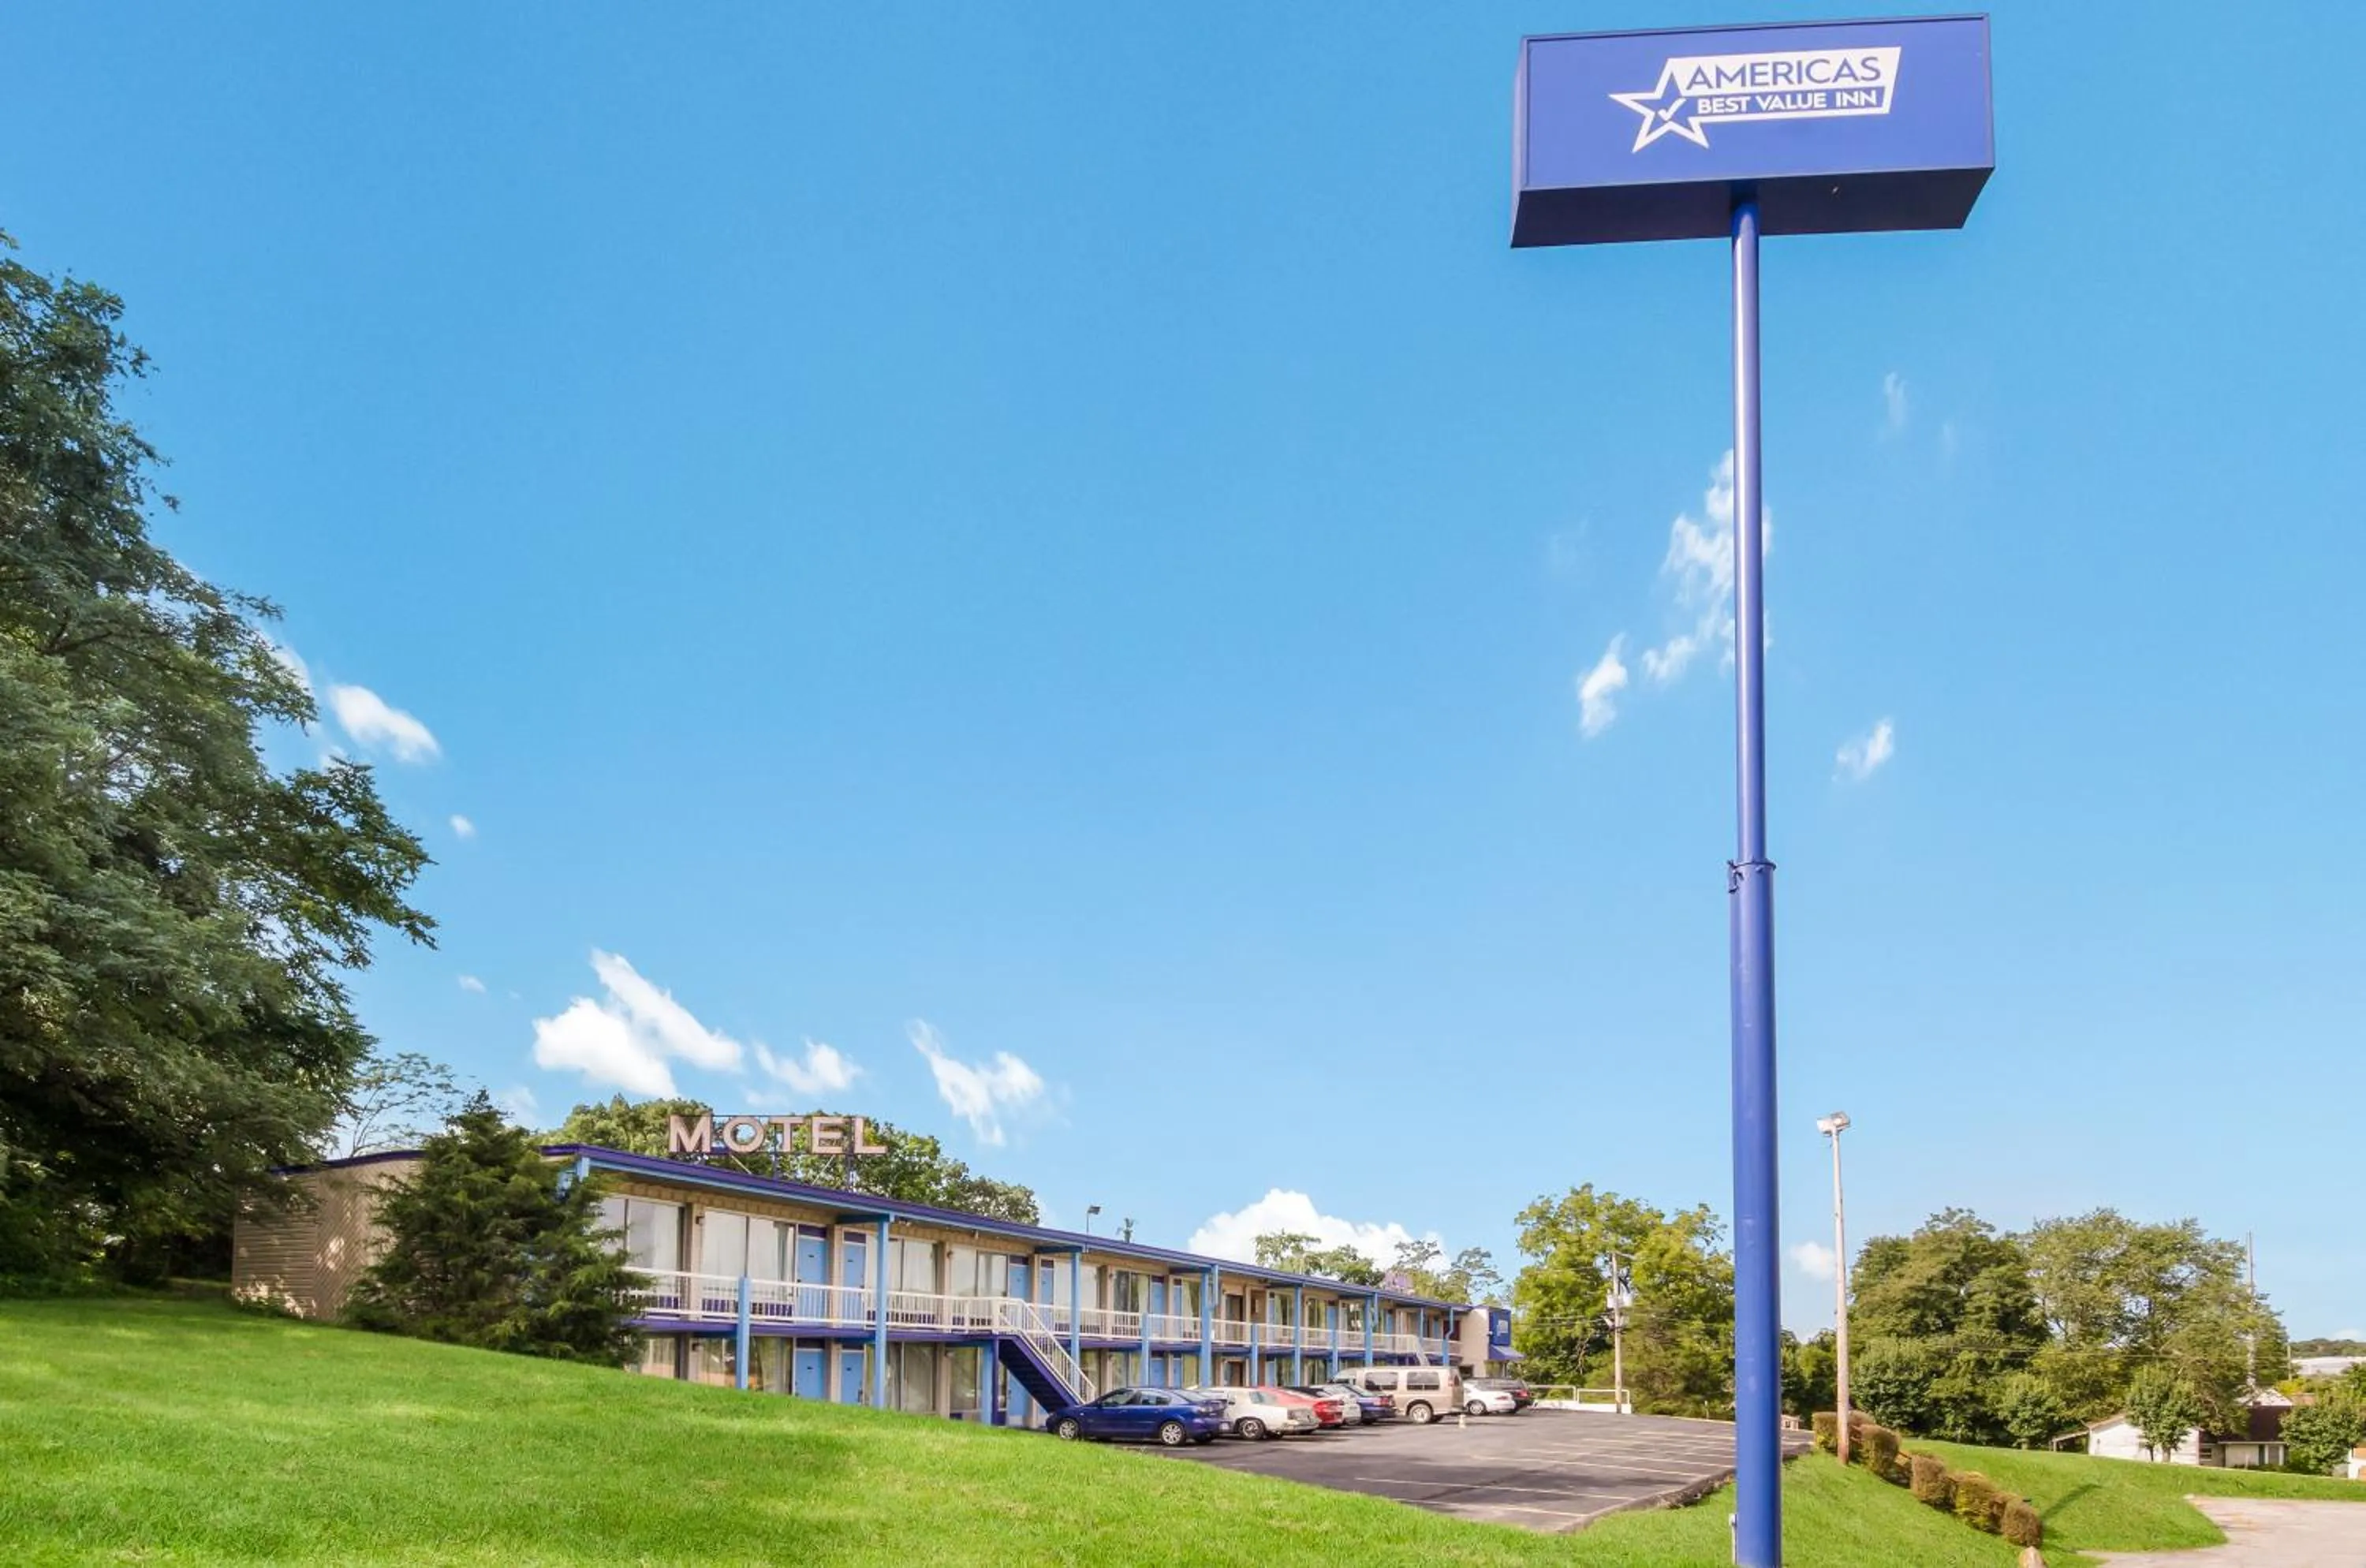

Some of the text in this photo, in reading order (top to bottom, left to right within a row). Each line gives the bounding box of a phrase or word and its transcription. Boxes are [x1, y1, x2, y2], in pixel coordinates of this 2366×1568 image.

[1686, 57, 1881, 90] AMERICAS
[1698, 90, 1877, 114] BEST VALUE INN
[669, 1114, 888, 1155] MOTEL
